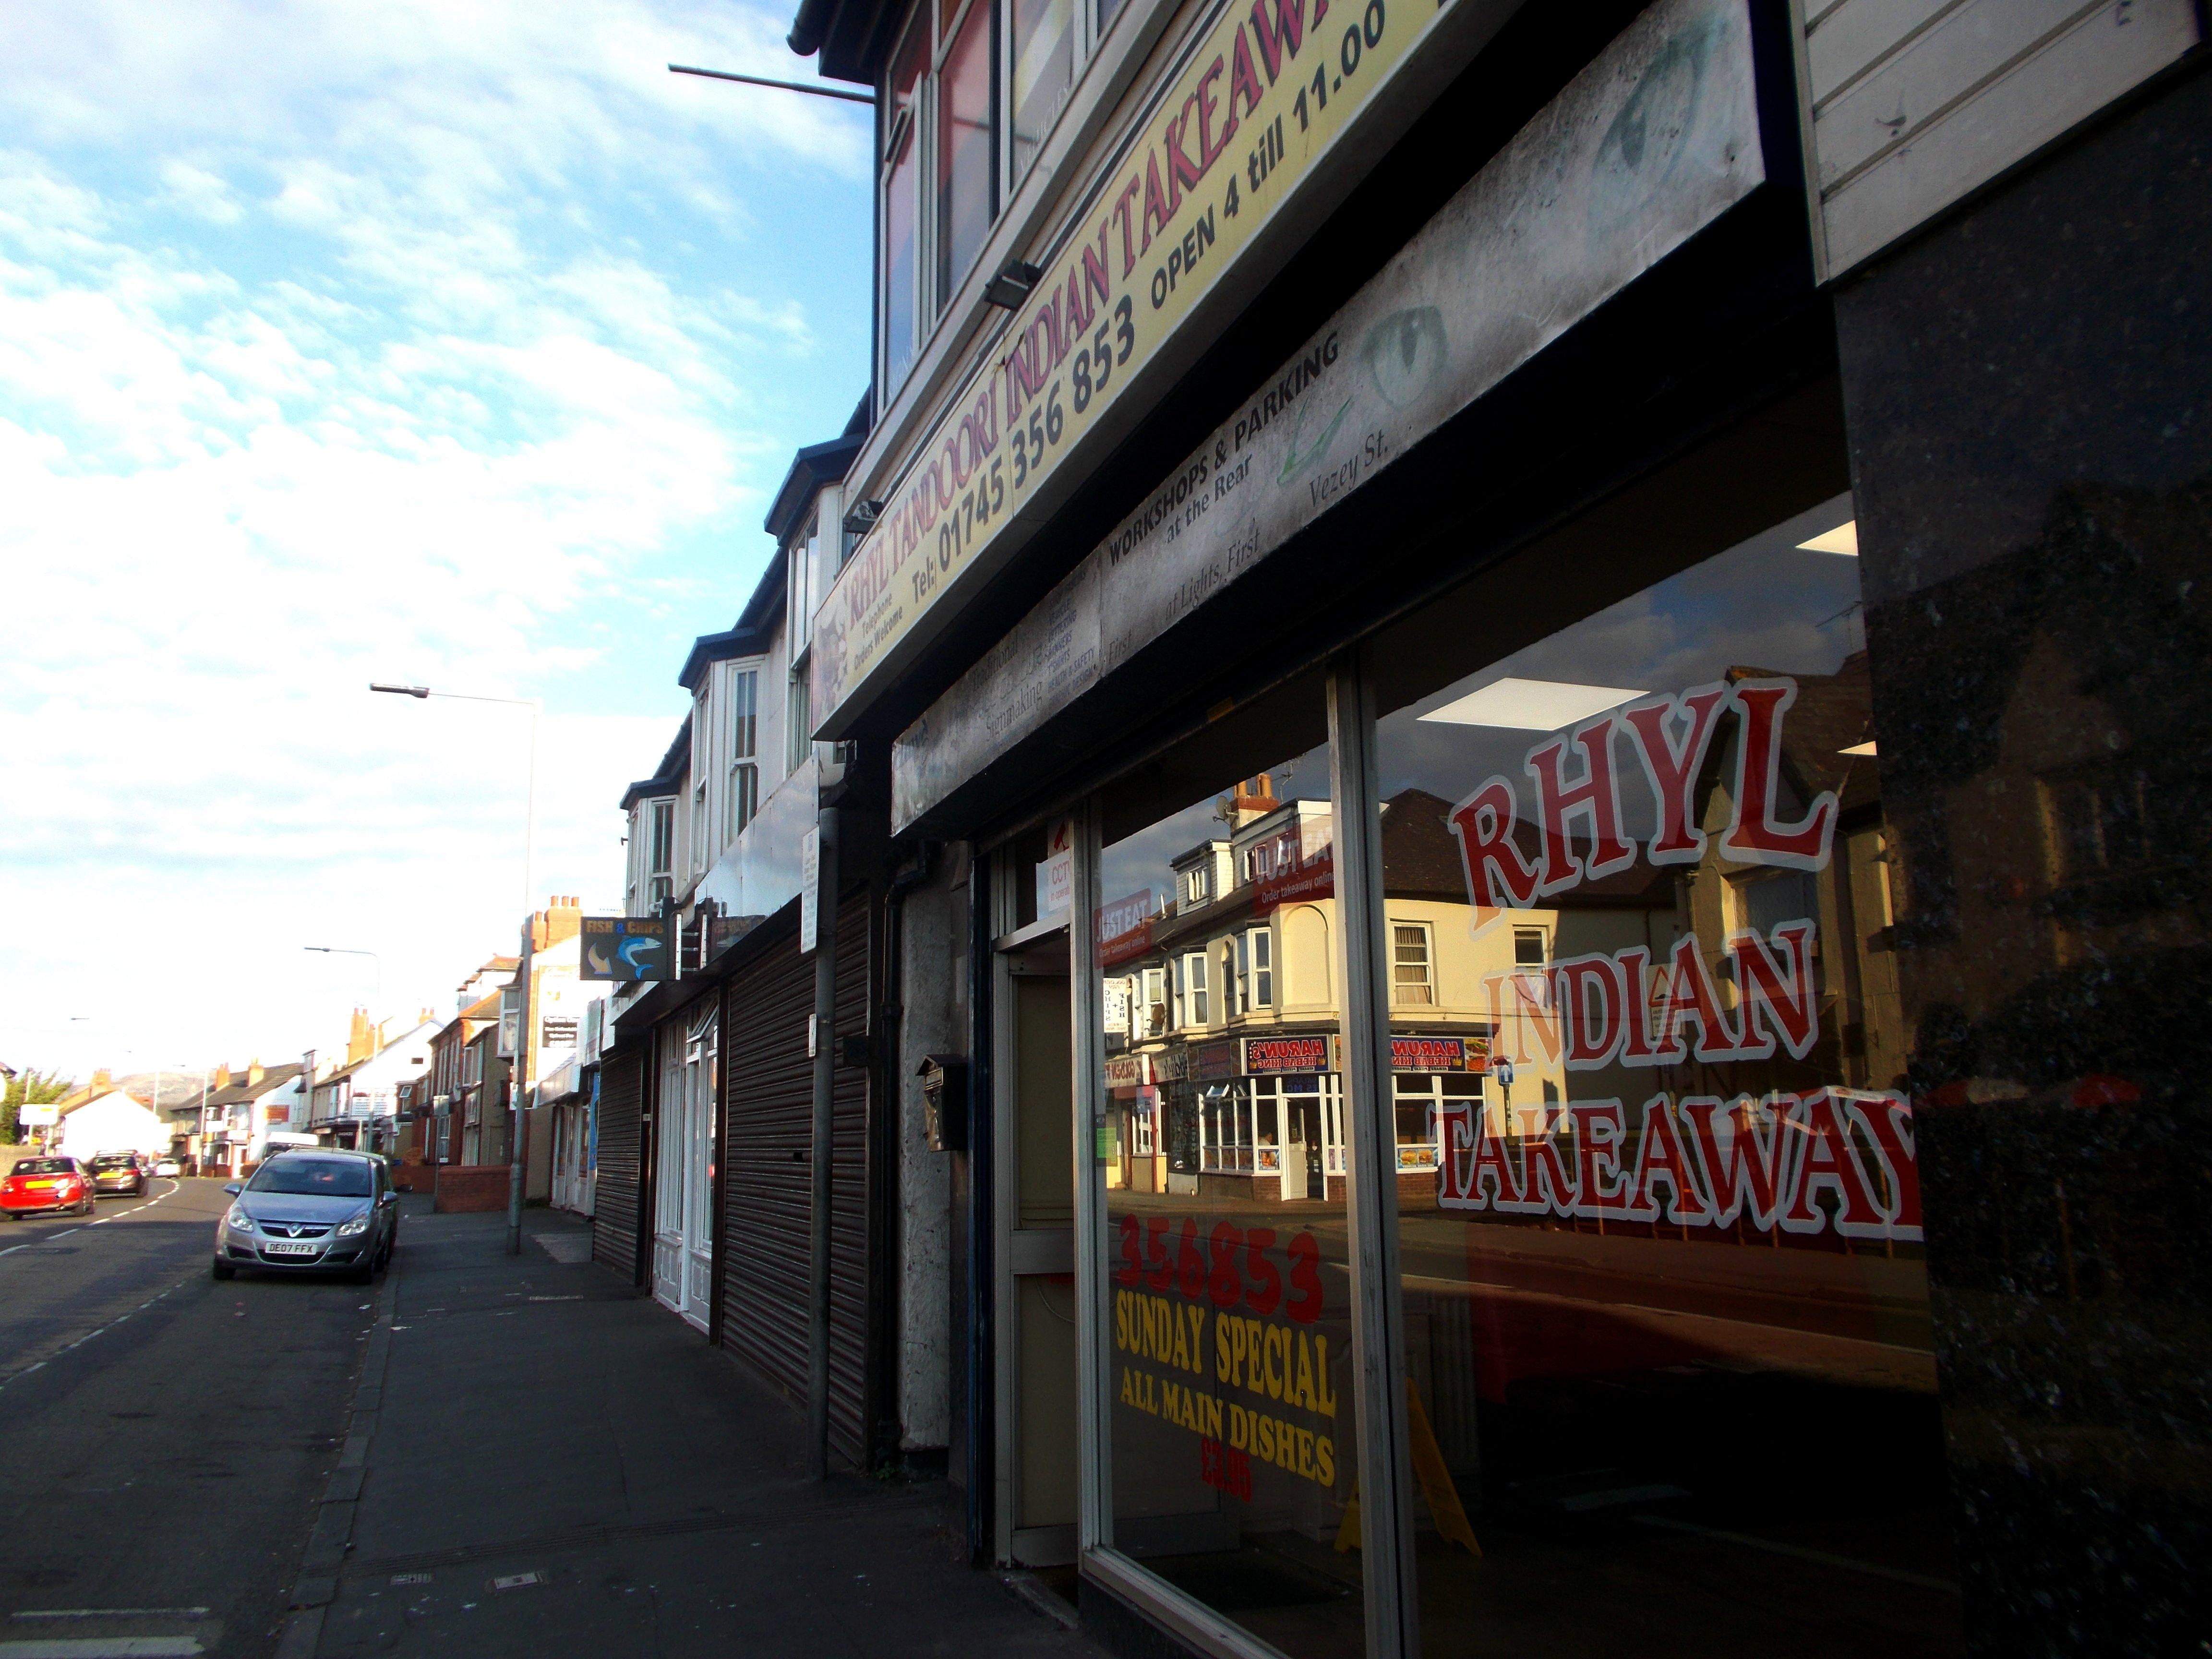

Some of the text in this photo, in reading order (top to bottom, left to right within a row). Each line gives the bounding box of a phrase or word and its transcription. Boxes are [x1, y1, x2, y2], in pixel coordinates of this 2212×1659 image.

[912, 0, 1386, 604] Tel: 01745 356 853 OPEN 4 till 11.00
[843, 538, 890, 631] RHYL
[889, 376, 998, 574] TANDOORI
[1005, 217, 1110, 431] INDIAN
[1109, 330, 1339, 567] WORKSHOPS & PARKING
[1166, 455, 1253, 544] at the Rear
[1309, 429, 1388, 509] Vezey St.
[854, 606, 902, 671] Orders Welcome
[863, 592, 892, 638] Telephone
[1108, 530, 1261, 663] First at Lights, First
[1074, 646, 1095, 673] SAFETY
[986, 680, 1043, 742] Signmaking
[1450, 678, 1839, 938] RHYL
[1257, 840, 1299, 884] JUST
[1262, 888, 1280, 904] Order
[1281, 878, 1313, 897] takeaway
[586, 920, 664, 934] FISH & CHIPS
[1096, 899, 1147, 943] JUST EAT
[1478, 918, 1816, 1078] INDIAN
[1427, 1084, 1924, 1242] TAKEAWAY
[268, 1243, 313, 1253] DE07 FFX
[1118, 1213, 1323, 1325] 356853
[1116, 1288, 1336, 1419] SUNDAY SPECIAL
[1120, 1366, 1335, 1487] ALL MAIN DISHES
